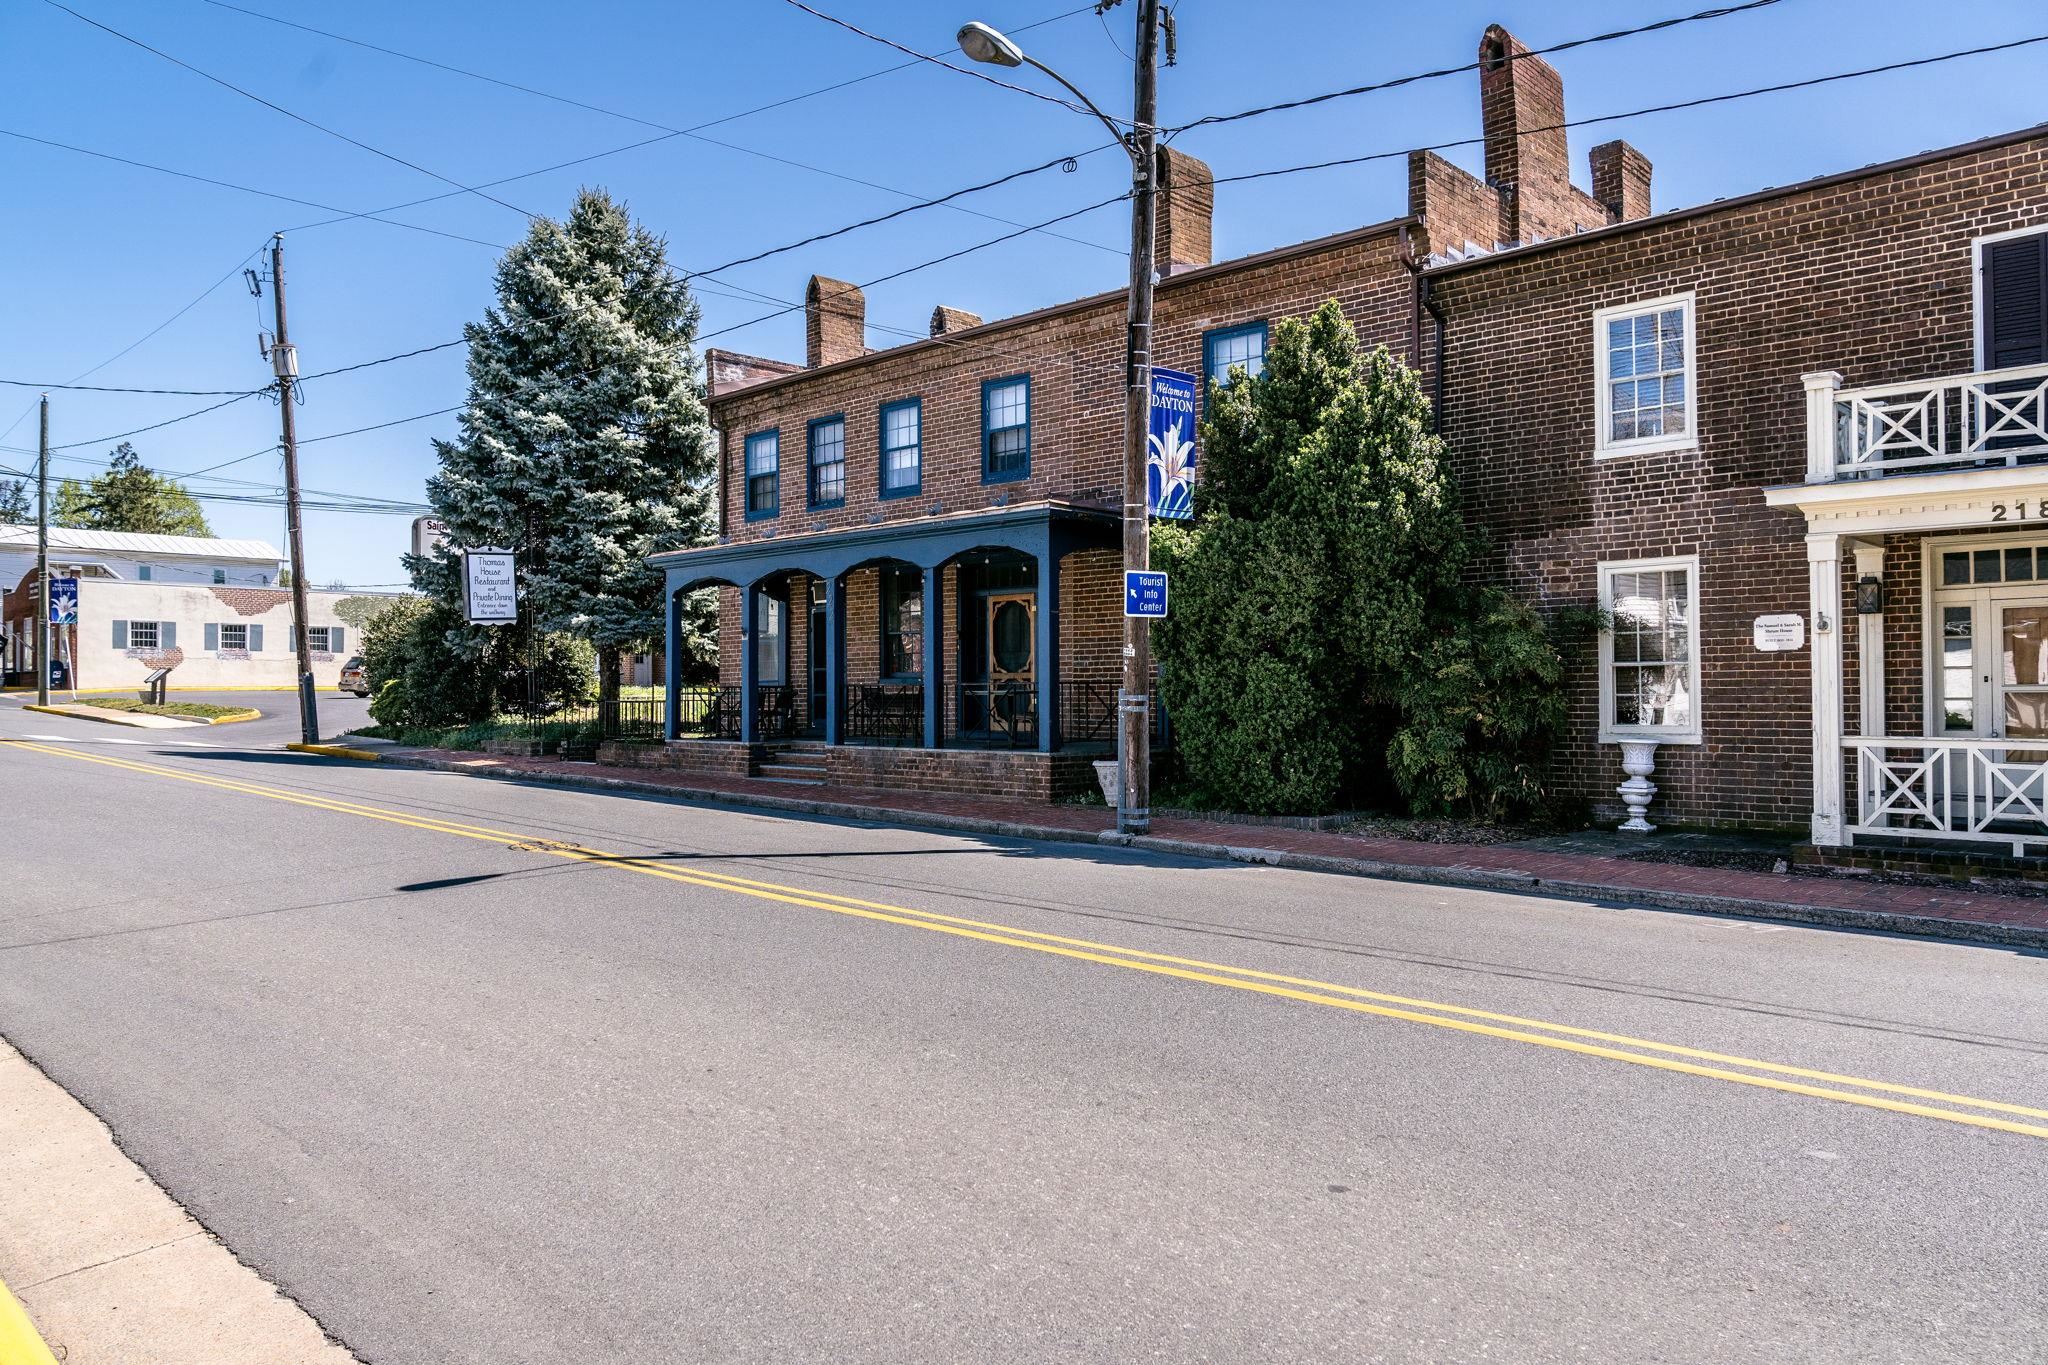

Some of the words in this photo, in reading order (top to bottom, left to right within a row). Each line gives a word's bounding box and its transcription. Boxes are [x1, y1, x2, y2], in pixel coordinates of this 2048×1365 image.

[1156, 382, 1183, 396] Welcome
[1184, 390, 1191, 398] to
[1152, 394, 1193, 413] DAYTON
[478, 557, 505, 565] Thomas
[480, 567, 501, 576] House
[474, 576, 510, 585] Restaurant
[1139, 577, 1163, 586] Tourist
[473, 592, 494, 601] Private
[494, 592, 513, 602] Dining
[1144, 589, 1158, 599] Info
[1139, 602, 1162, 612] Center
